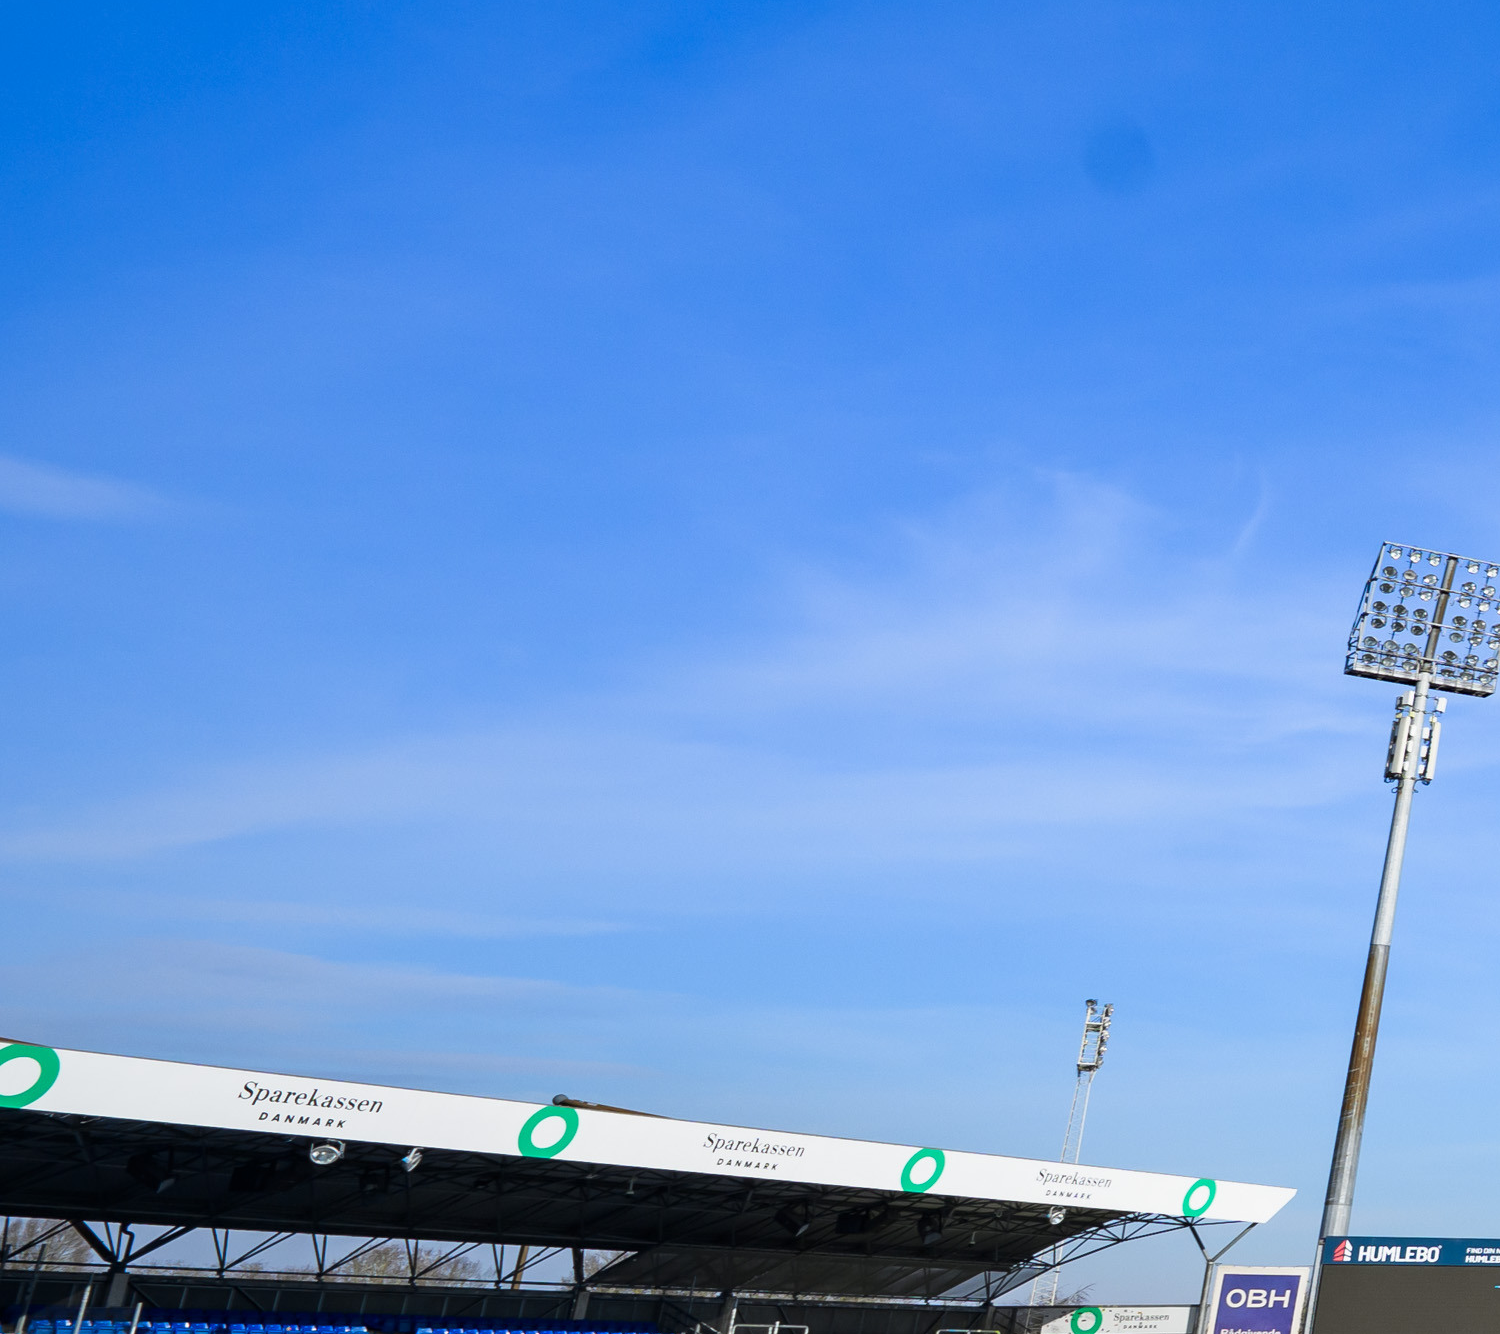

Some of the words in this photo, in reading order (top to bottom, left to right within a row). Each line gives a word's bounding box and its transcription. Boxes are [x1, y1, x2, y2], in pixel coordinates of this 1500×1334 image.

[238, 1080, 383, 1113] Sparekassen
[258, 1112, 347, 1128] DANMARK
[702, 1132, 804, 1157] Sparekassen
[717, 1158, 779, 1171] DANMARK
[1036, 1168, 1112, 1188] Sparekassen
[1226, 1288, 1291, 1308] OBH
[1113, 1313, 1170, 1323] Sparekassen
